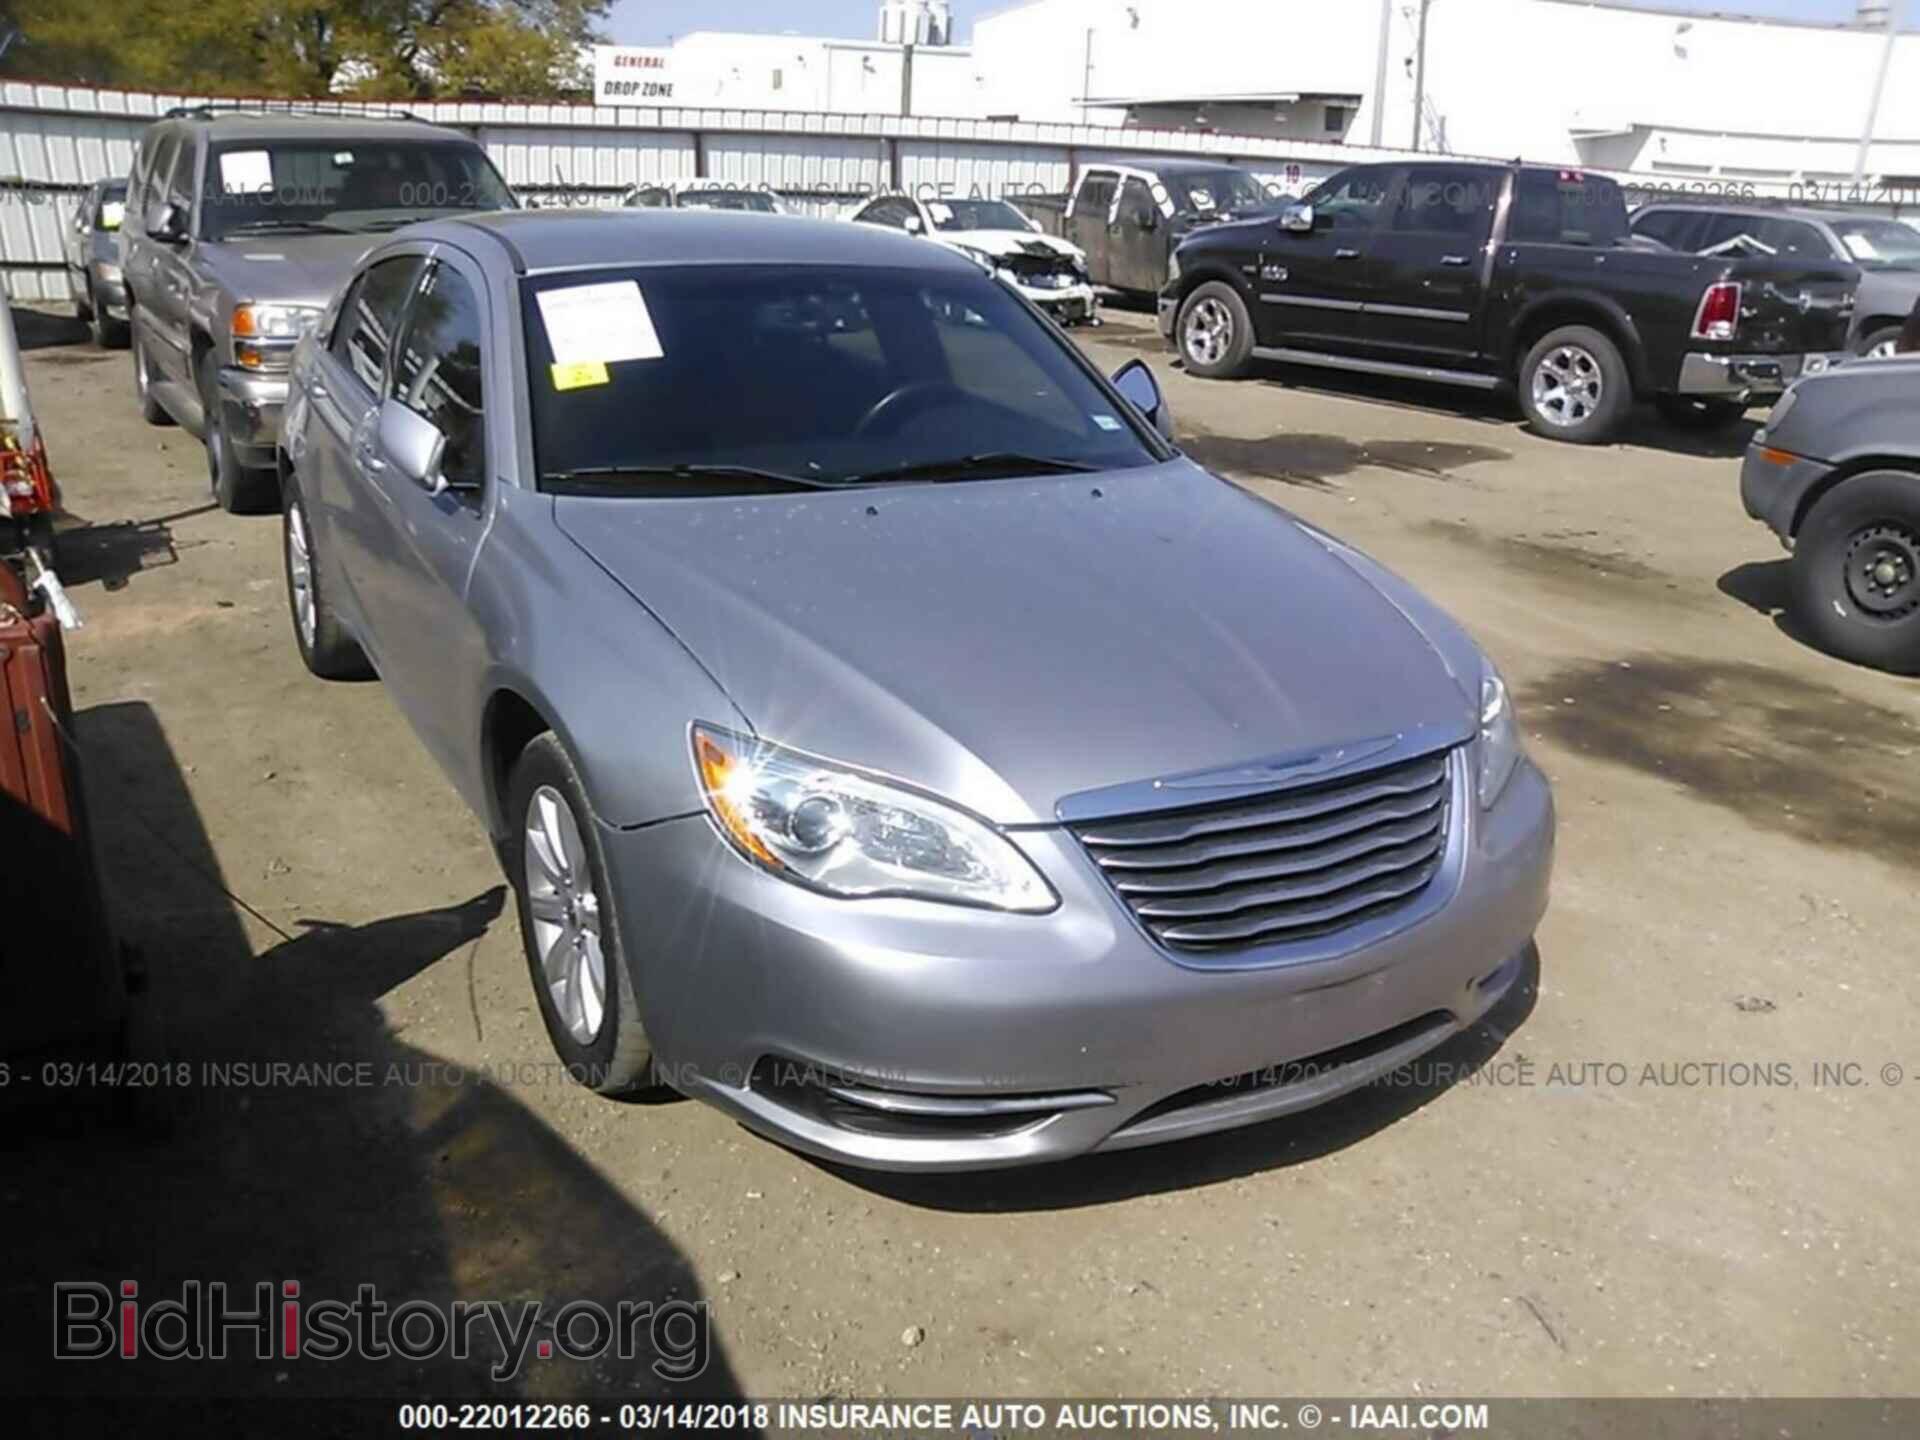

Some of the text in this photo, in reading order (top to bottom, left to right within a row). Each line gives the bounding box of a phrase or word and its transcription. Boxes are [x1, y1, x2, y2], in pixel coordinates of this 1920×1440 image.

[614, 55, 665, 69] GENERAL
[604, 81, 674, 97] DROP ZONE
